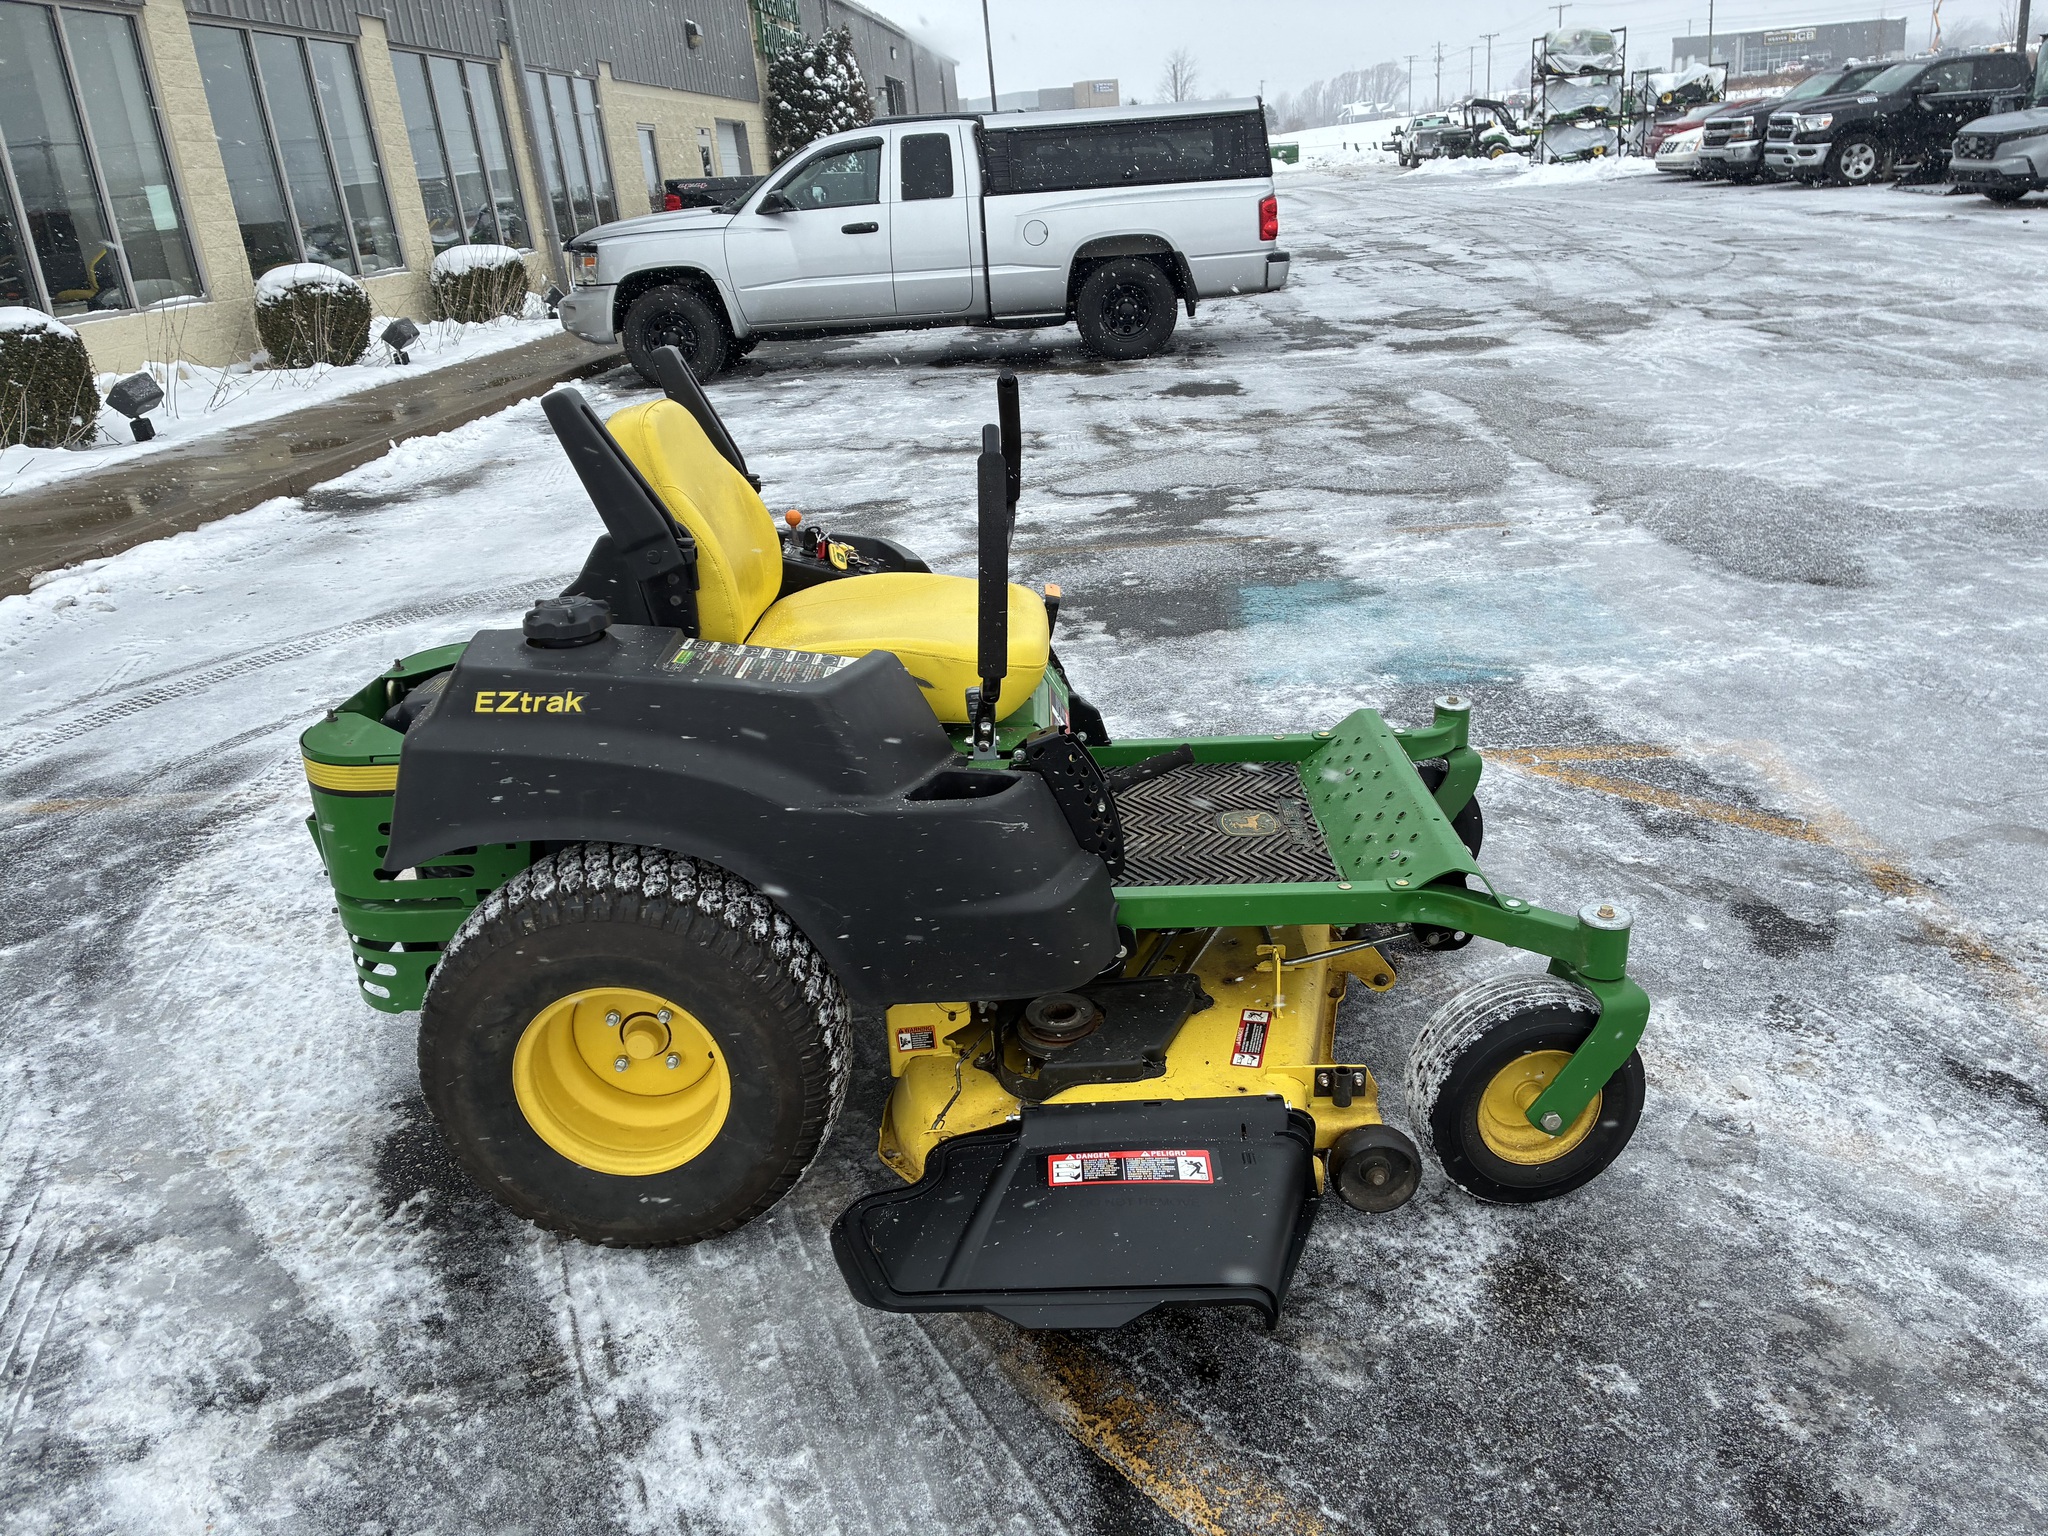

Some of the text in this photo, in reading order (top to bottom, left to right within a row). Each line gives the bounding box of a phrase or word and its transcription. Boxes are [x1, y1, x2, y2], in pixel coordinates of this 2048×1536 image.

[1792, 32, 1815, 42] JCB
[474, 691, 585, 713] EZtrak
[1138, 1197, 1200, 1208] REMOVE
